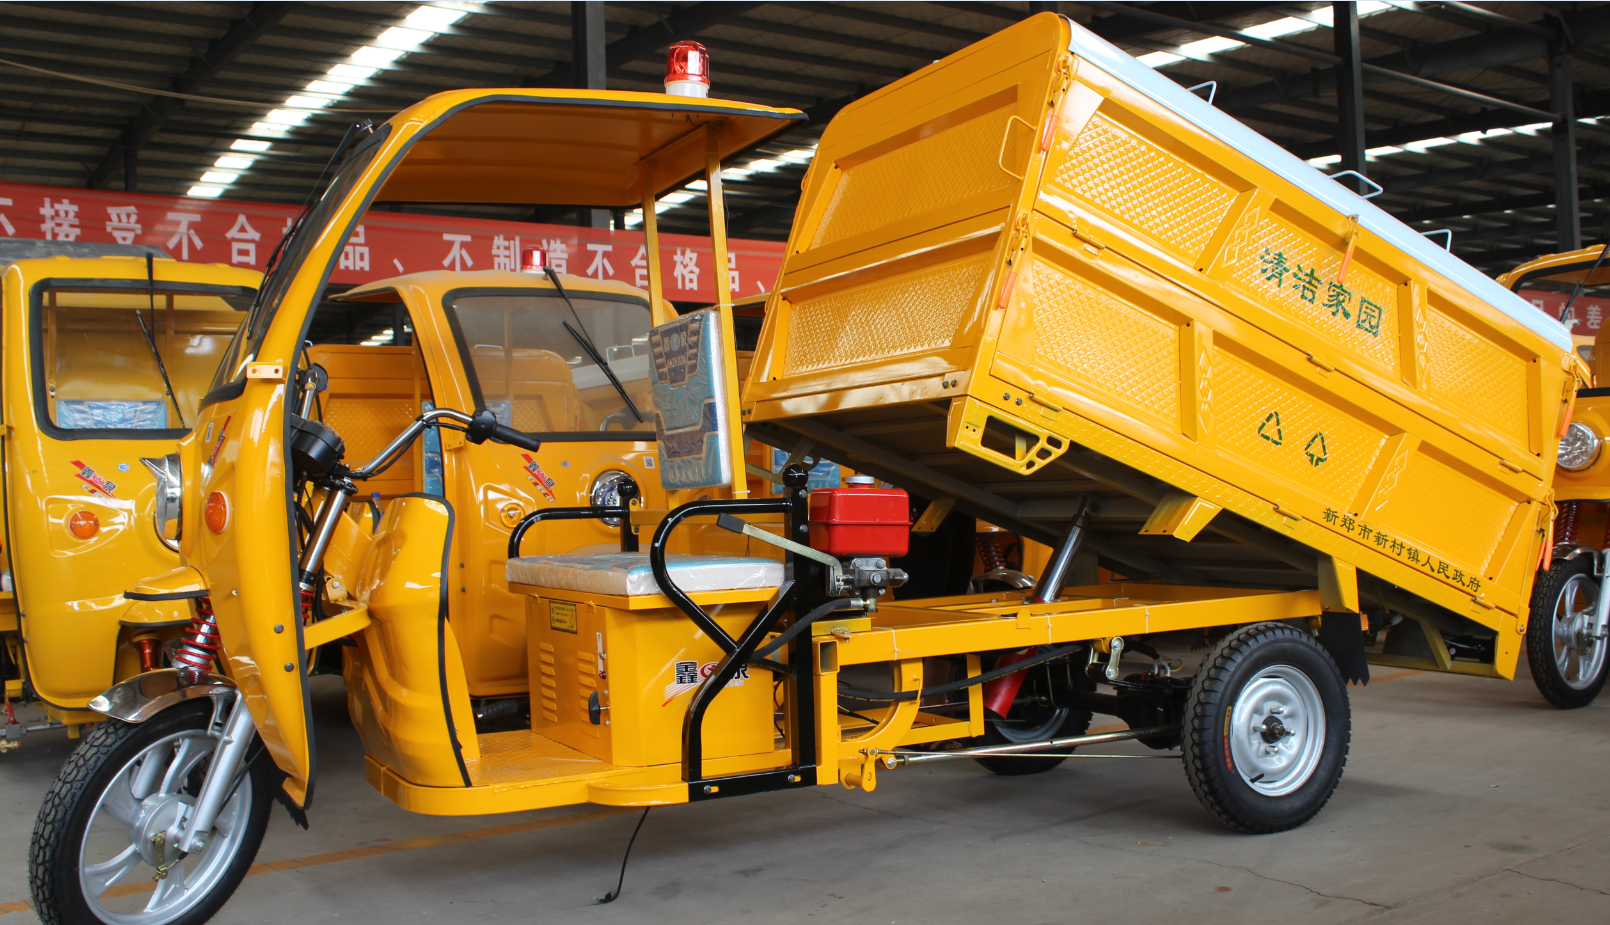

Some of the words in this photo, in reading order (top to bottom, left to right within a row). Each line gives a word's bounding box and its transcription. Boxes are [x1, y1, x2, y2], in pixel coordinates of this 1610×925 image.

[1261, 247, 1383, 337] 清洁家园
[1322, 507, 1482, 593] 新郑市新村镇人民政府
